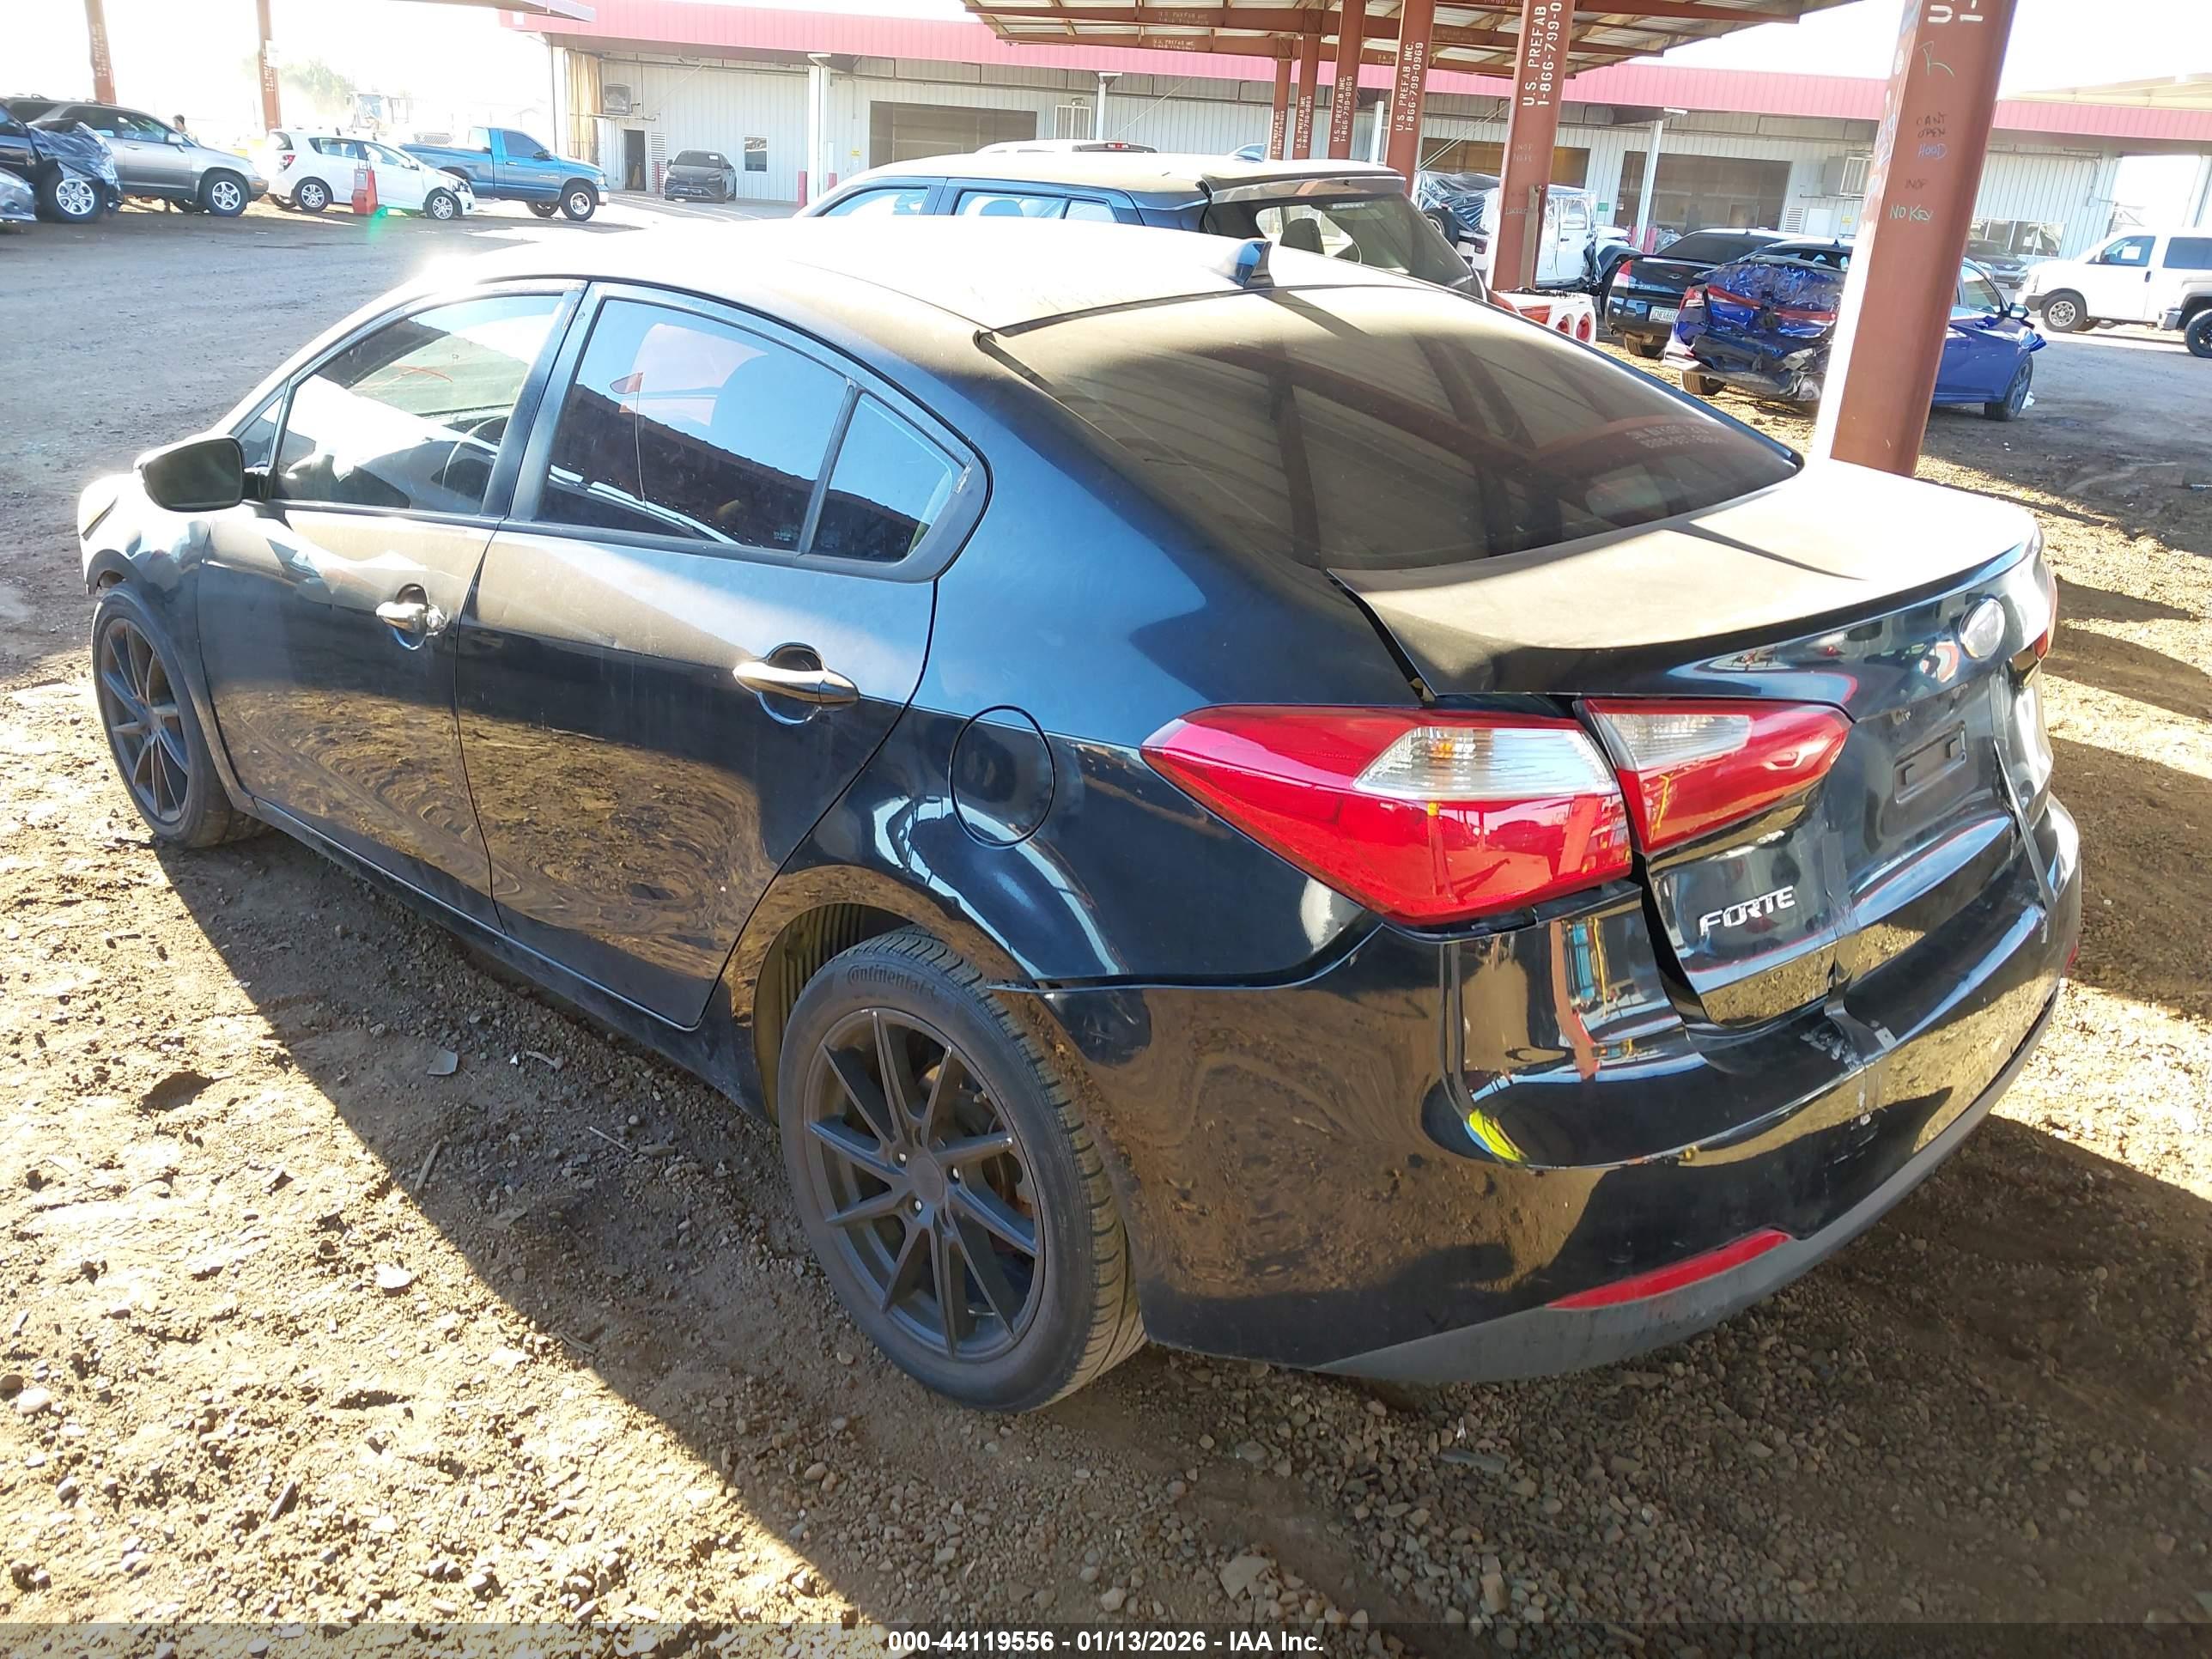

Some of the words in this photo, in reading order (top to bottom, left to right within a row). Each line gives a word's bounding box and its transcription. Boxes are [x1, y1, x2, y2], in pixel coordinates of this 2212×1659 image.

[1927, 0, 1954, 23] U
[1404, 40, 1414, 61] INC.
[1527, 6, 1547, 68] PREFAB
[1536, 2, 1563, 106] 1-866-799-0
[1398, 65, 1411, 106] PREFAB
[1405, 41, 1425, 131] 1-866-799-0969
[1522, 76, 1538, 106] U.S.
[1334, 93, 1345, 124] PREFAB
[1395, 112, 1406, 131] U.S.
[1917, 143, 1948, 160] HOOD
[1890, 204, 1906, 220] NO
[1698, 884, 1796, 937] FORTE
